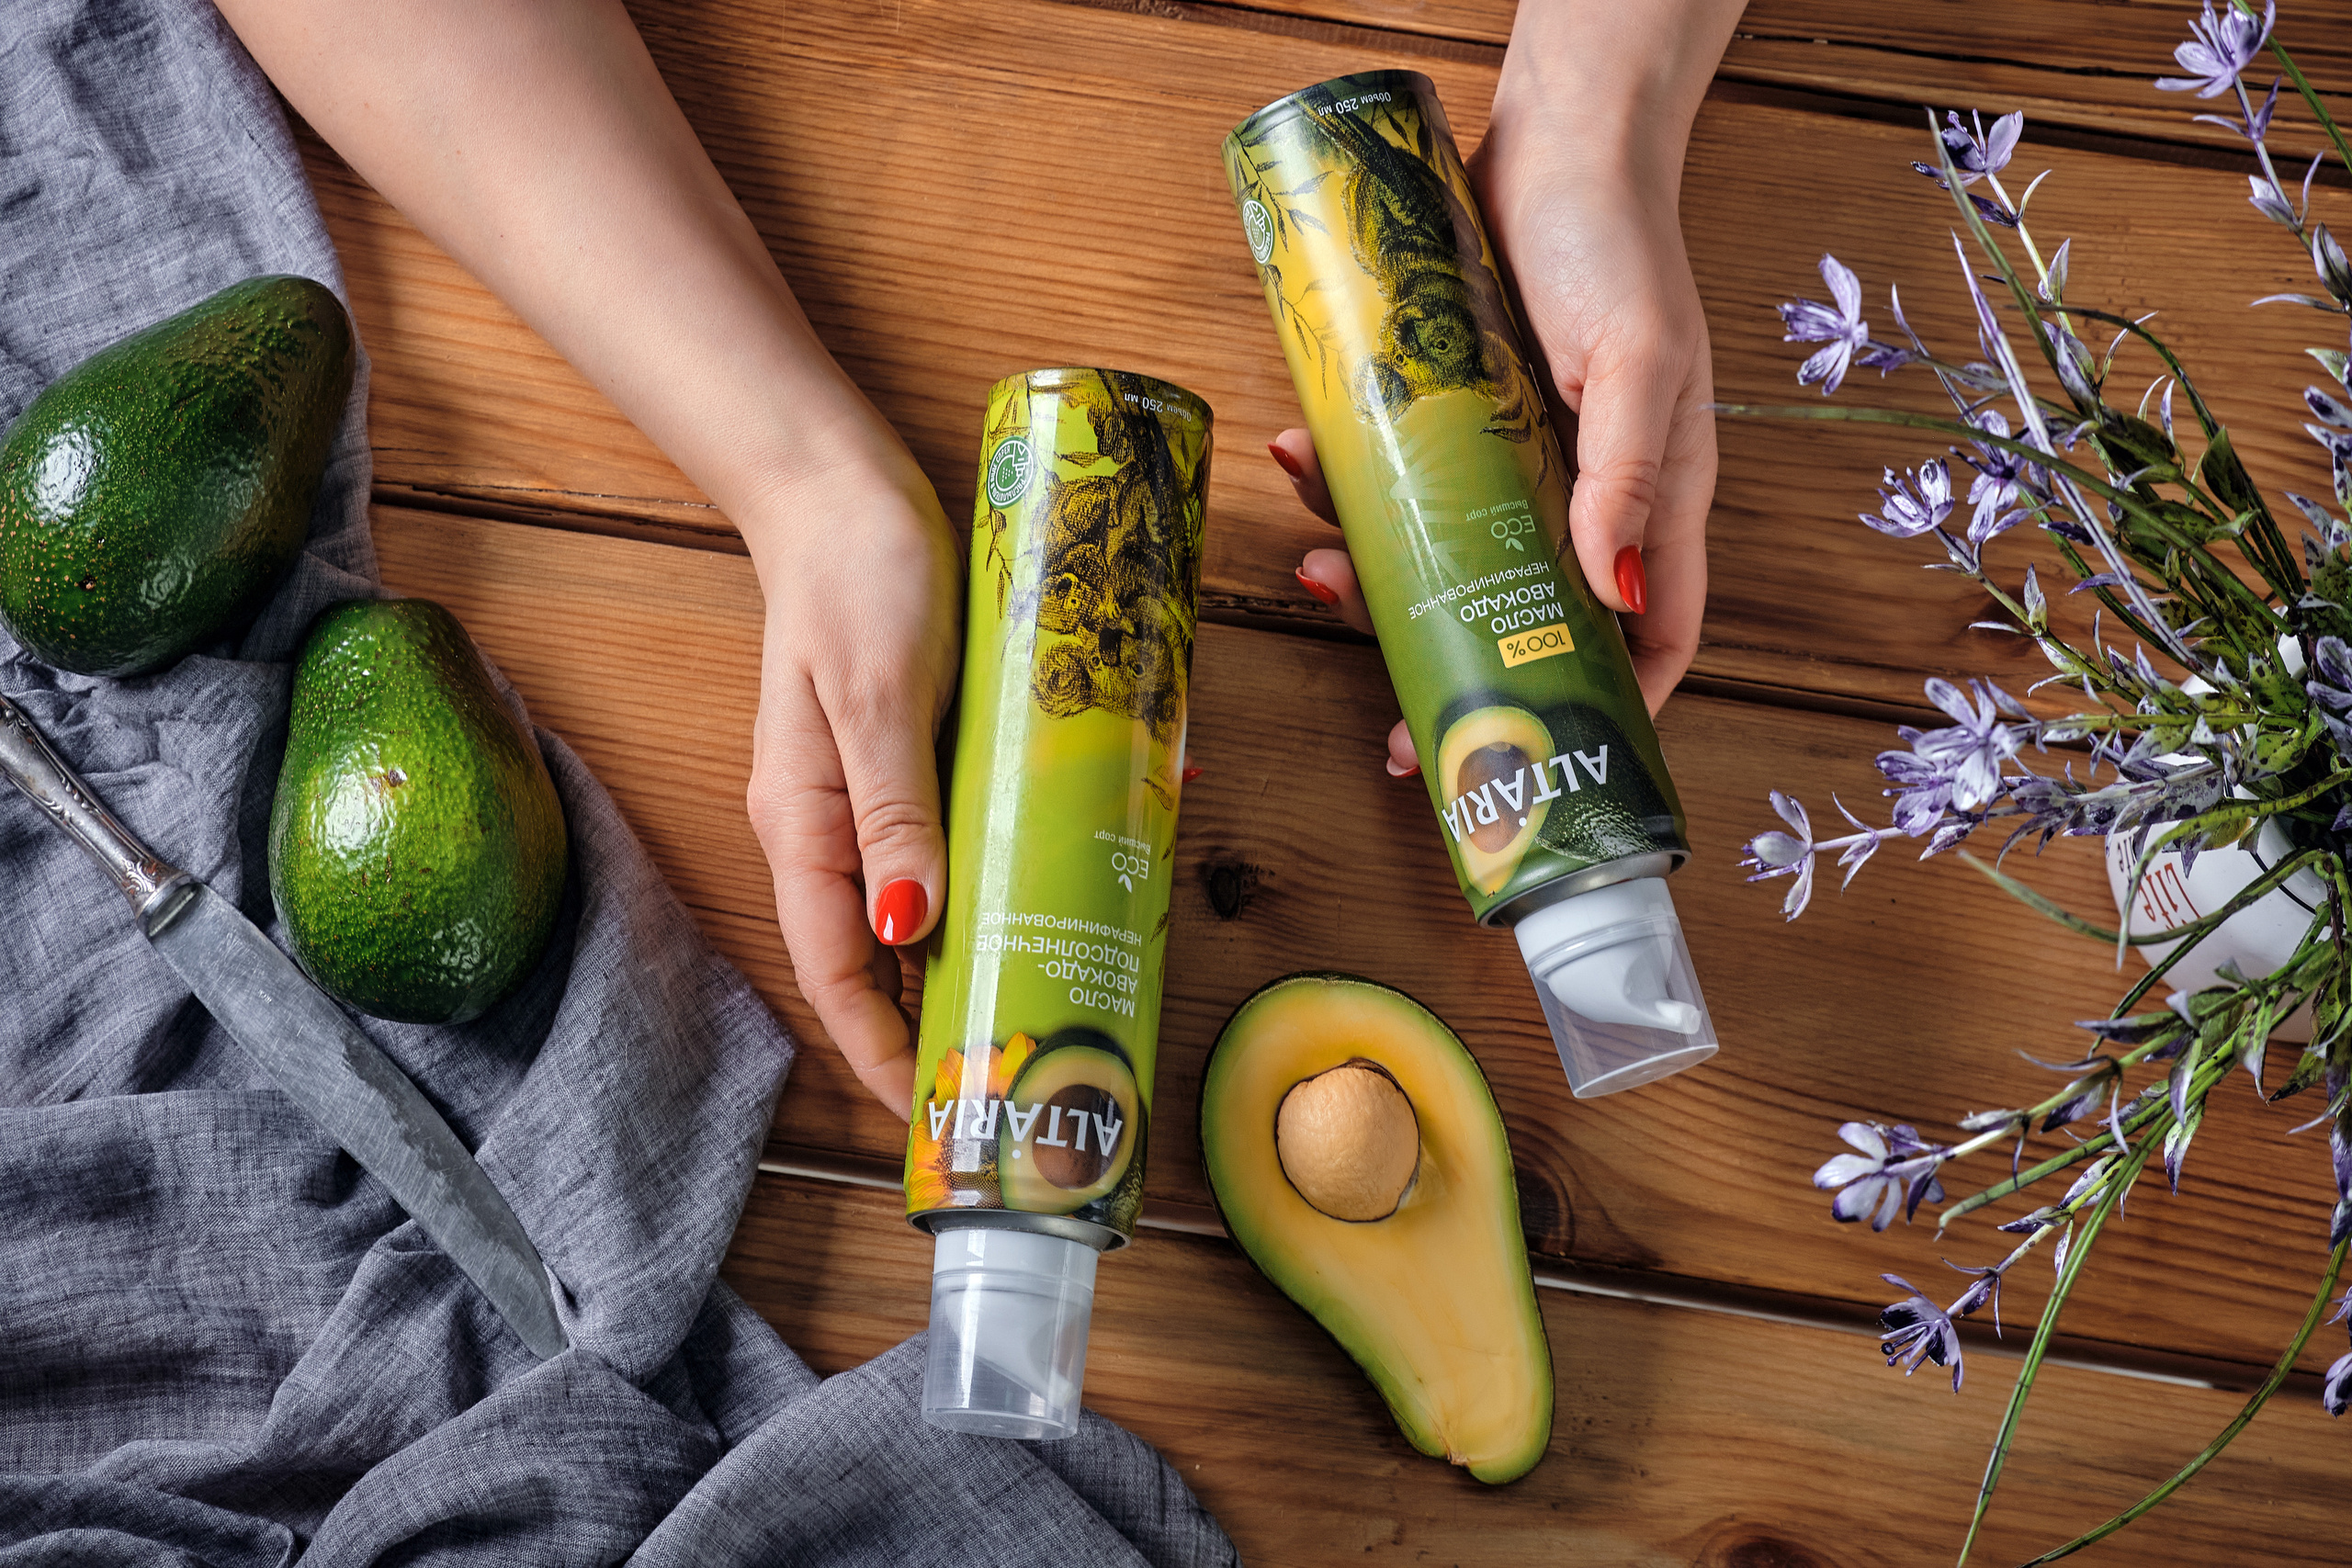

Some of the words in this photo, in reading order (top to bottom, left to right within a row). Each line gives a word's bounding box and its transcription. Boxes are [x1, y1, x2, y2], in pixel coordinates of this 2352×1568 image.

[1317, 105, 1333, 117] мл
[1335, 97, 1359, 114] 250
[1360, 91, 1392, 105] Объем
[1124, 393, 1139, 403] мл
[1142, 397, 1163, 413] 250
[1166, 403, 1192, 423] Объем
[1465, 508, 1488, 522] сорт
[1489, 499, 1529, 516] Высший
[1490, 514, 1536, 539] ECO
[1408, 560, 1550, 620] НЕРАФИНИРОВАННОЕ
[1460, 581, 1555, 623] АВОКАДО
[1490, 602, 1565, 635] МАСЛО
[1506, 630, 1566, 659] 100%
[1441, 744, 1609, 844] ALTARIA
[1093, 829, 1116, 842] сорт
[1111, 852, 1149, 880] ECO
[981, 911, 1142, 947] НЕРАФИНИРОВАННОЕ
[976, 933, 1139, 973] ПОДСОЛНЕЧНОЕ
[1037, 958, 1137, 994] АВОКАДО-
[1069, 987, 1136, 1018] МАСЛО
[928, 1099, 1124, 1159] ALTARIA
